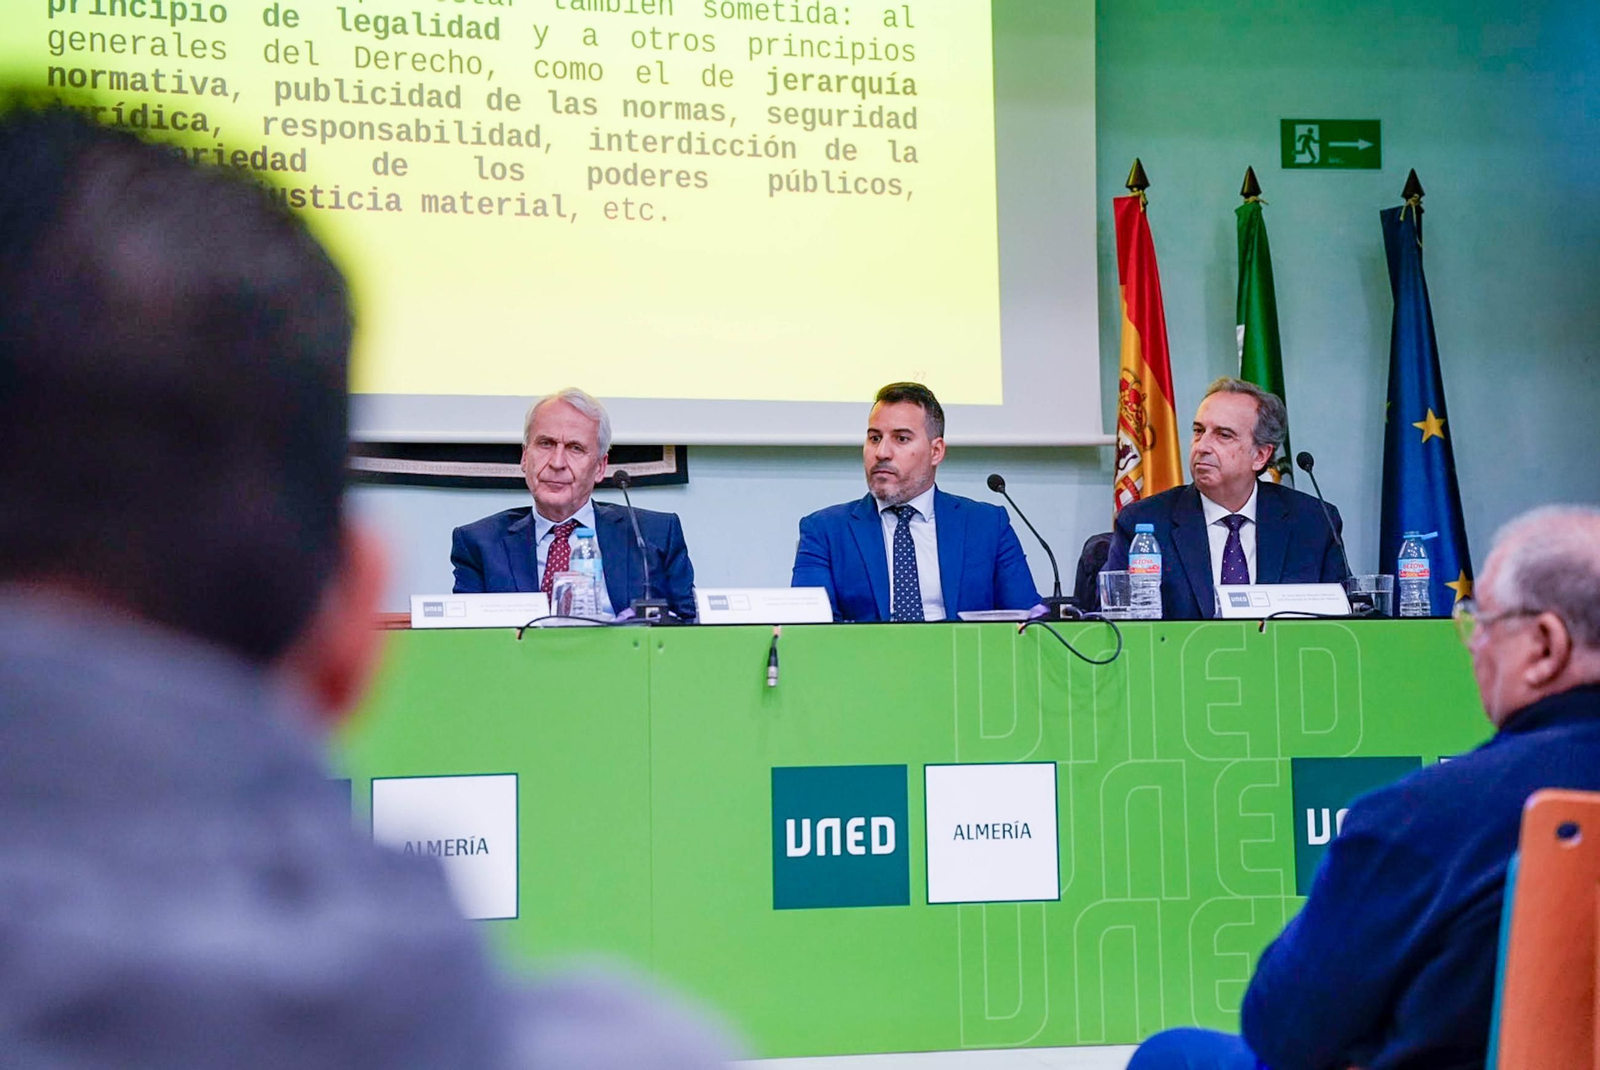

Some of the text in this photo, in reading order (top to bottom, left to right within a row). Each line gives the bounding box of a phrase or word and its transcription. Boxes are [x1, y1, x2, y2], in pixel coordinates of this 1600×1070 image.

[48, 0, 916, 66] principio de legalidad y a otros principios
[704, 0, 853, 26] sometida:
[883, 4, 915, 29] al
[48, 28, 917, 100] generales del Derecho, como el de jerarquía
[48, 65, 918, 131] normativa, publicidad de las normas, seguridad
[263, 113, 553, 154] responsabilidad,
[589, 129, 797, 160] interdicción
[824, 140, 858, 162] de
[887, 140, 918, 164] la
[372, 152, 408, 176] de
[474, 156, 525, 181] los
[587, 164, 709, 190] poderes
[768, 171, 914, 202] públicos,
[421, 190, 579, 224] material,
[603, 202, 668, 222] etc.
[786, 816, 896, 857] UNED
[953, 820, 1032, 841] ALMERÍA
